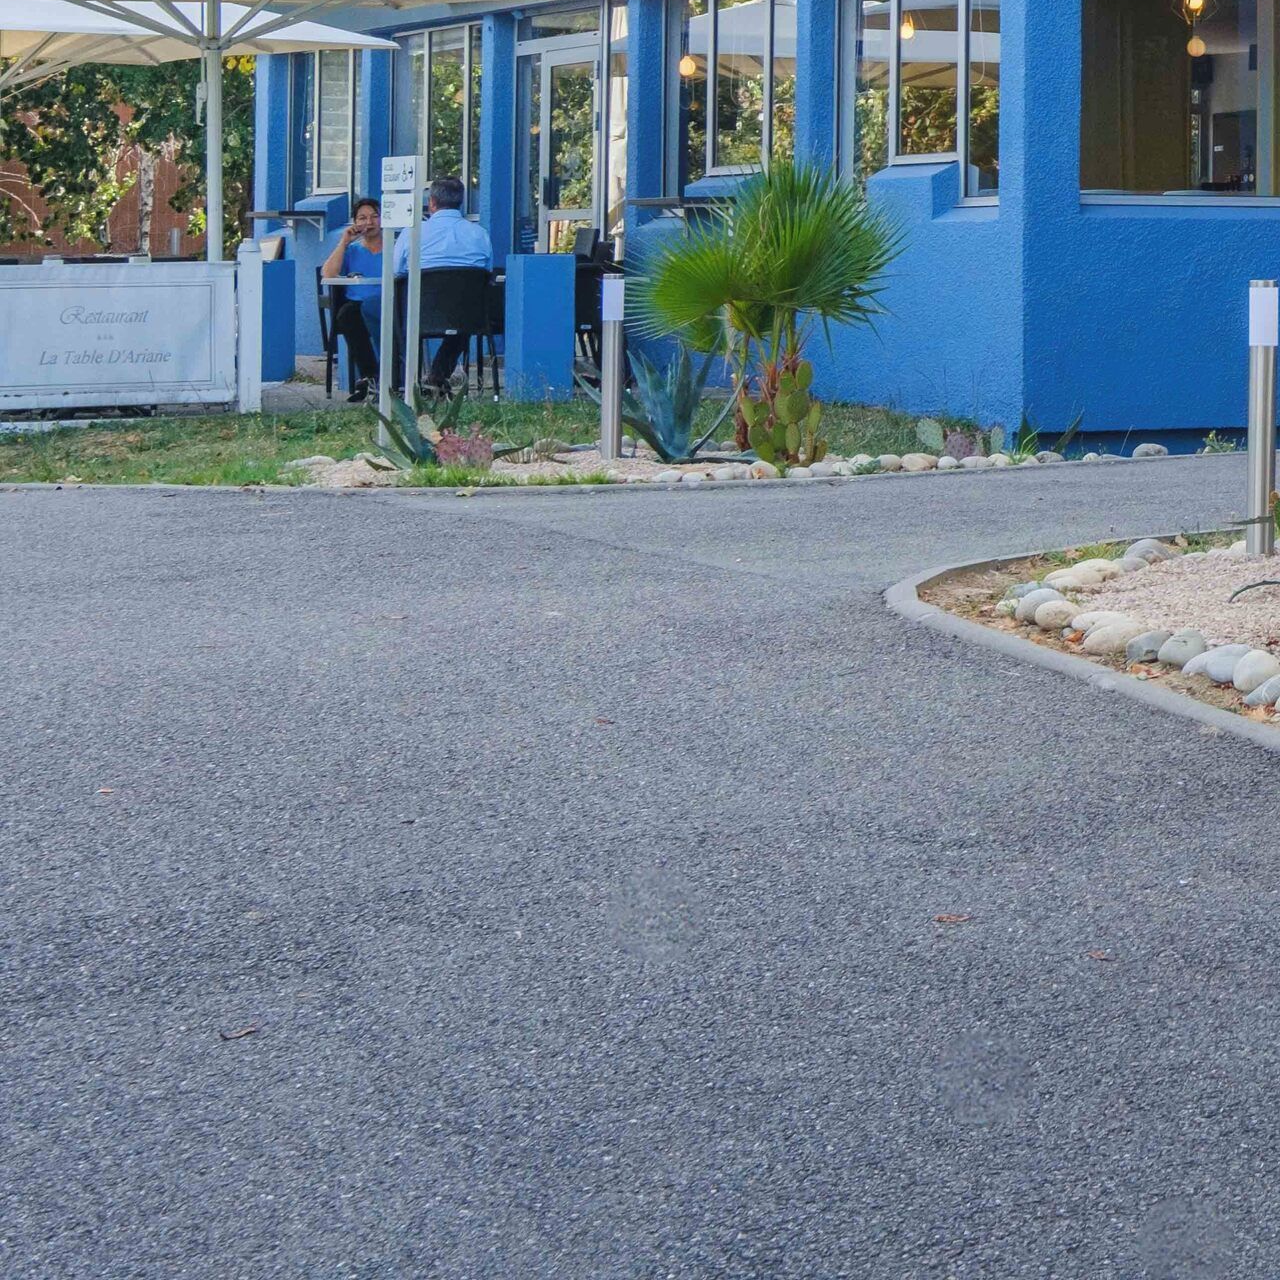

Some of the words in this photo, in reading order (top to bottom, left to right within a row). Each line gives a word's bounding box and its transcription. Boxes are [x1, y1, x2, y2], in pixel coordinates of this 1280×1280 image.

[59, 305, 150, 325] Restaurant
[39, 350, 57, 366] La
[64, 349, 104, 365] Table
[108, 348, 172, 365] D'Ariane
